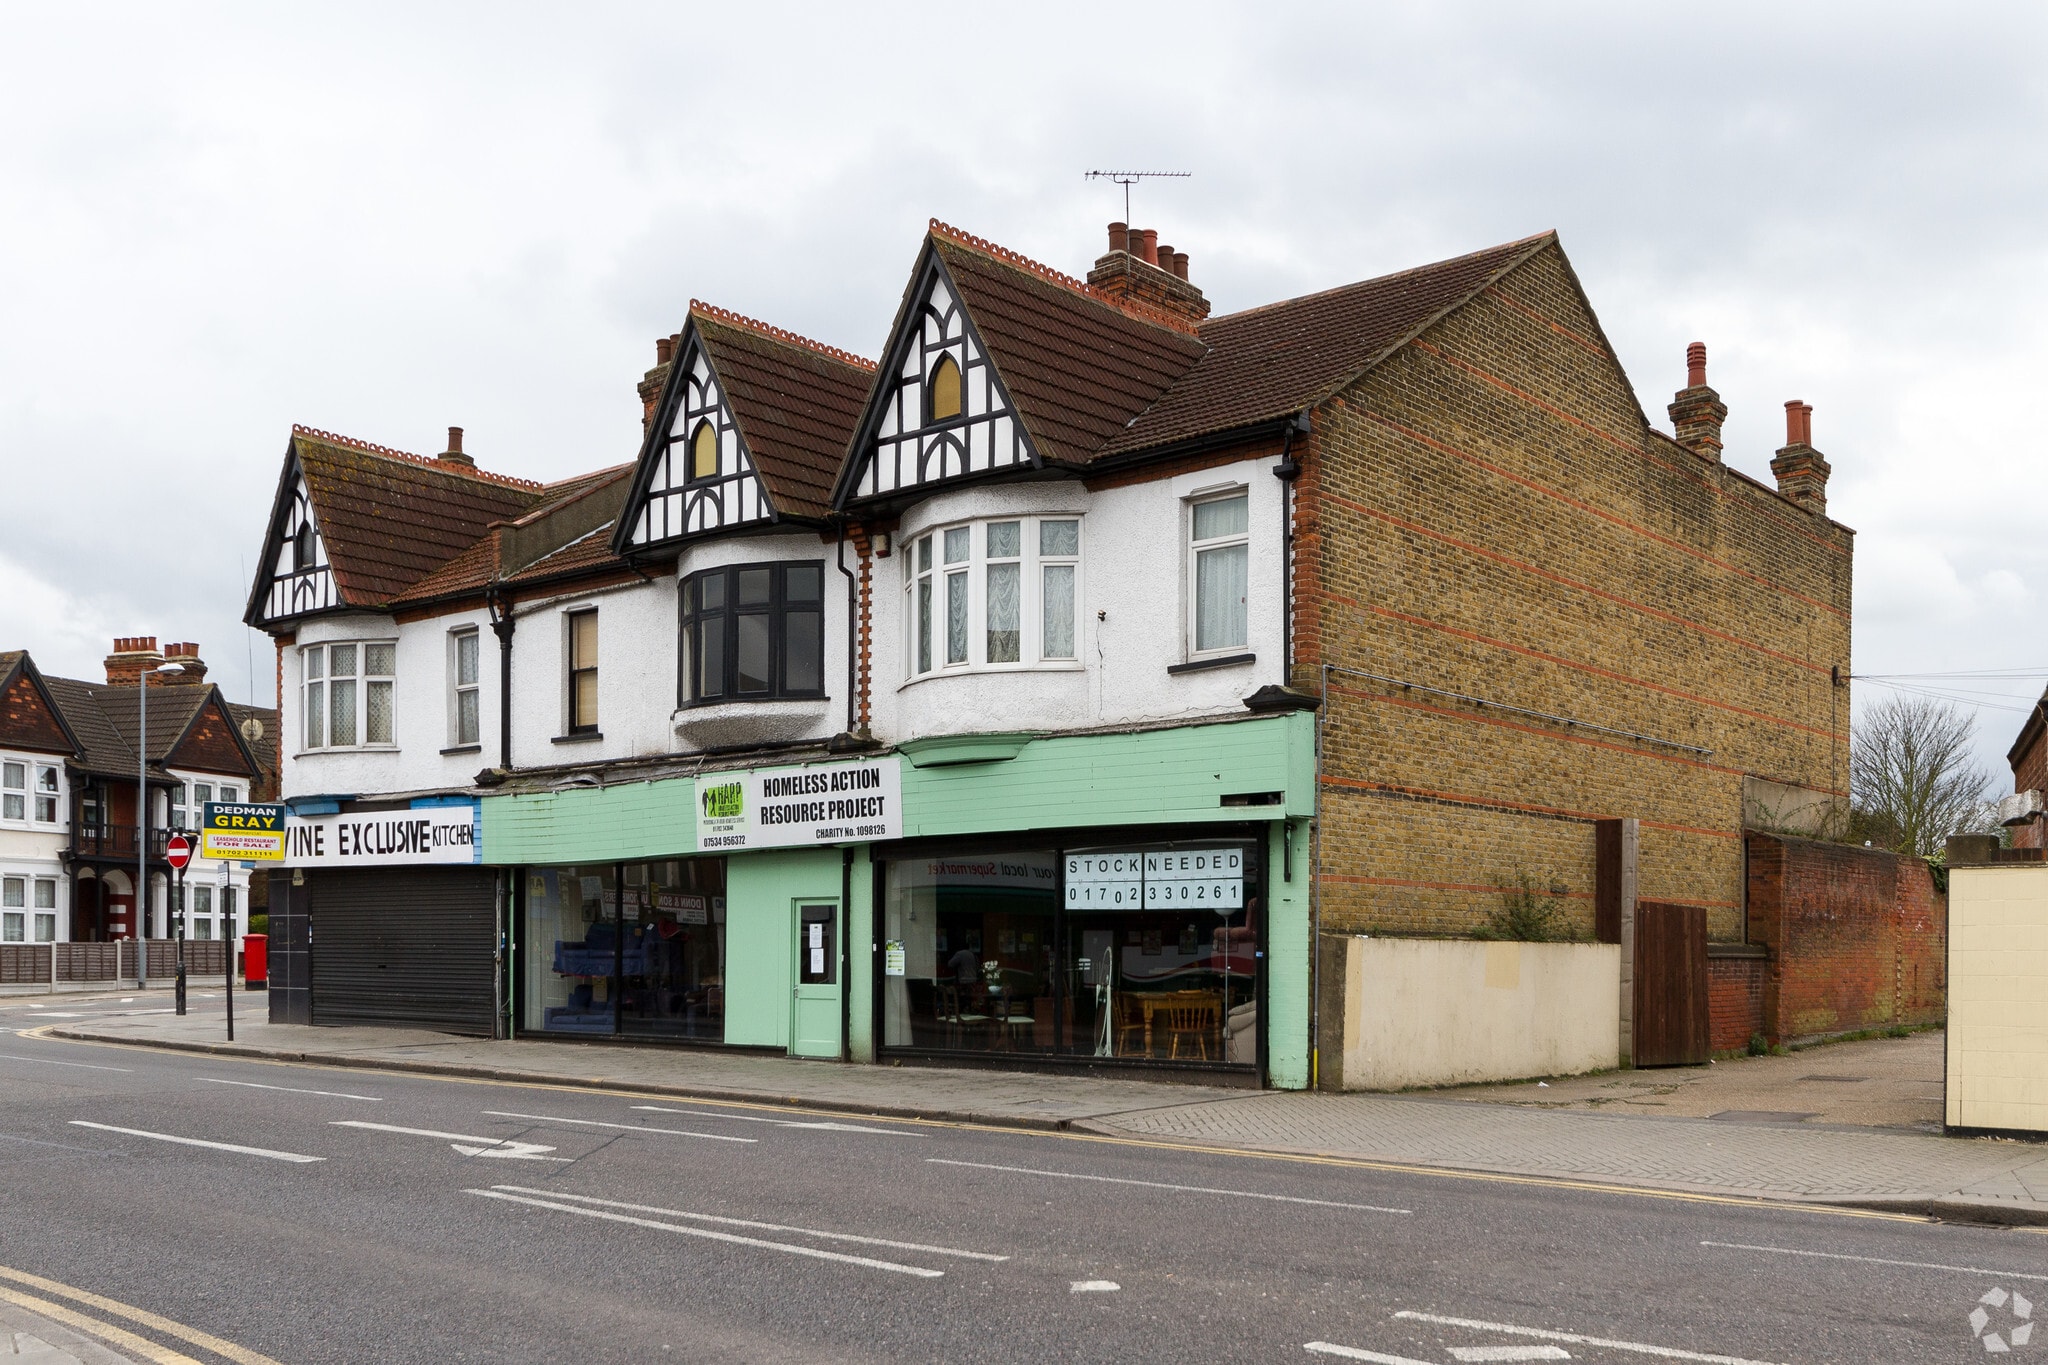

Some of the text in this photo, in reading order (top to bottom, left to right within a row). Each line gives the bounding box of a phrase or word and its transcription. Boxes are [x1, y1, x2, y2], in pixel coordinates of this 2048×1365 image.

[763, 767, 880, 798] HOMELESS ACTION
[213, 805, 277, 816] DEDMAN
[761, 801, 825, 825] RESOURCE
[828, 796, 885, 820] PROJECT
[214, 815, 276, 829] GRAY
[815, 824, 886, 839] CHARITY No. 1098126
[338, 820, 431, 856] EXCLUSIVE
[432, 823, 474, 847] KITCHEN
[703, 834, 746, 848] 07534 956372
[1069, 854, 1239, 874] STOCK NEEDED
[1069, 885, 1238, 904] 01702 330261
